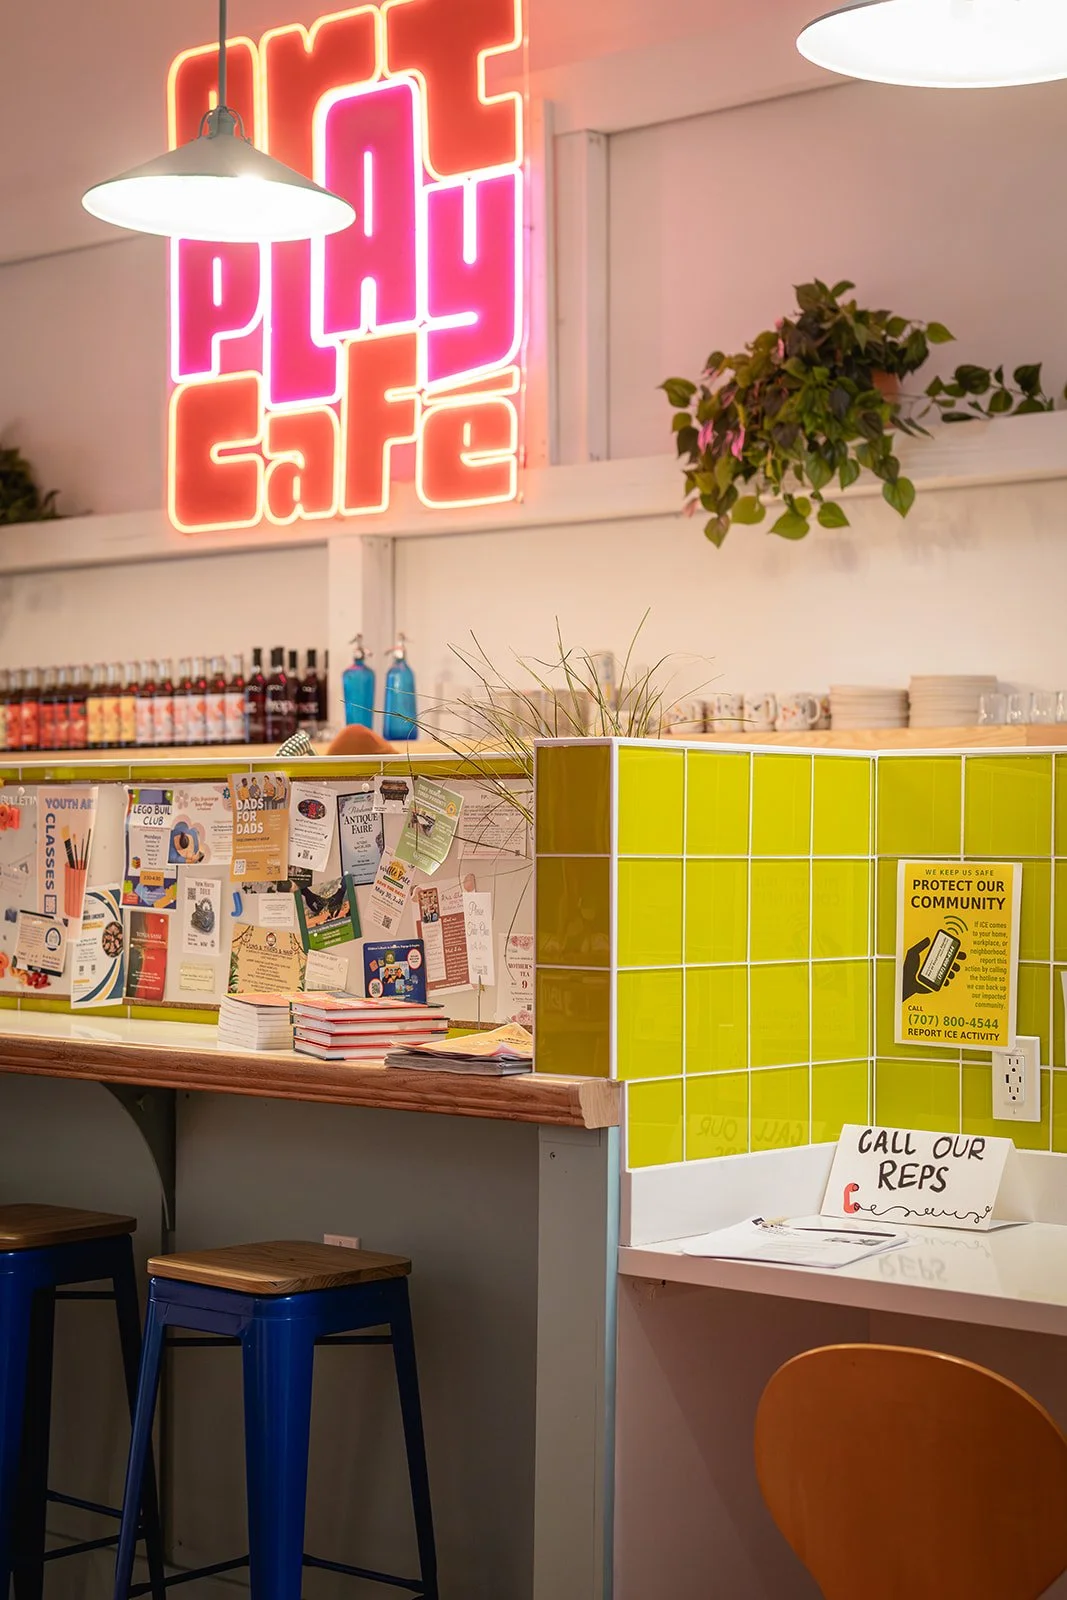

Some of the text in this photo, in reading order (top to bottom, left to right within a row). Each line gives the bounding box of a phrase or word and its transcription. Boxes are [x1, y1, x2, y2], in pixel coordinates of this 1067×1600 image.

[45, 798, 94, 810] YOUTH AR
[133, 805, 172, 815] LEGO BUIL
[236, 798, 264, 811] DADS
[143, 816, 164, 826] CLUB
[236, 811, 257, 823] FOR
[343, 813, 379, 826] ANTIQUE
[236, 822, 264, 835] DADS
[351, 824, 374, 835] FAIRE
[45, 812, 56, 890] CLASSES
[913, 879, 1005, 892] PROTECT OUR
[911, 895, 1006, 910] COMMUNITY
[991, 930, 1008, 939] home,
[970, 948, 1008, 956] neighborhood,
[996, 957, 1007, 965] this
[989, 966, 1007, 975] calling
[979, 974, 998, 982] hotline
[521, 980, 528, 989] 9
[981, 992, 1007, 1001] impacted
[908, 1013, 999, 1030] (707) 800-4544
[907, 1027, 1000, 1041] REPORT ICE ACTIVITY
[858, 1129, 986, 1161] CALL OUR
[878, 1160, 950, 1193] REPS
